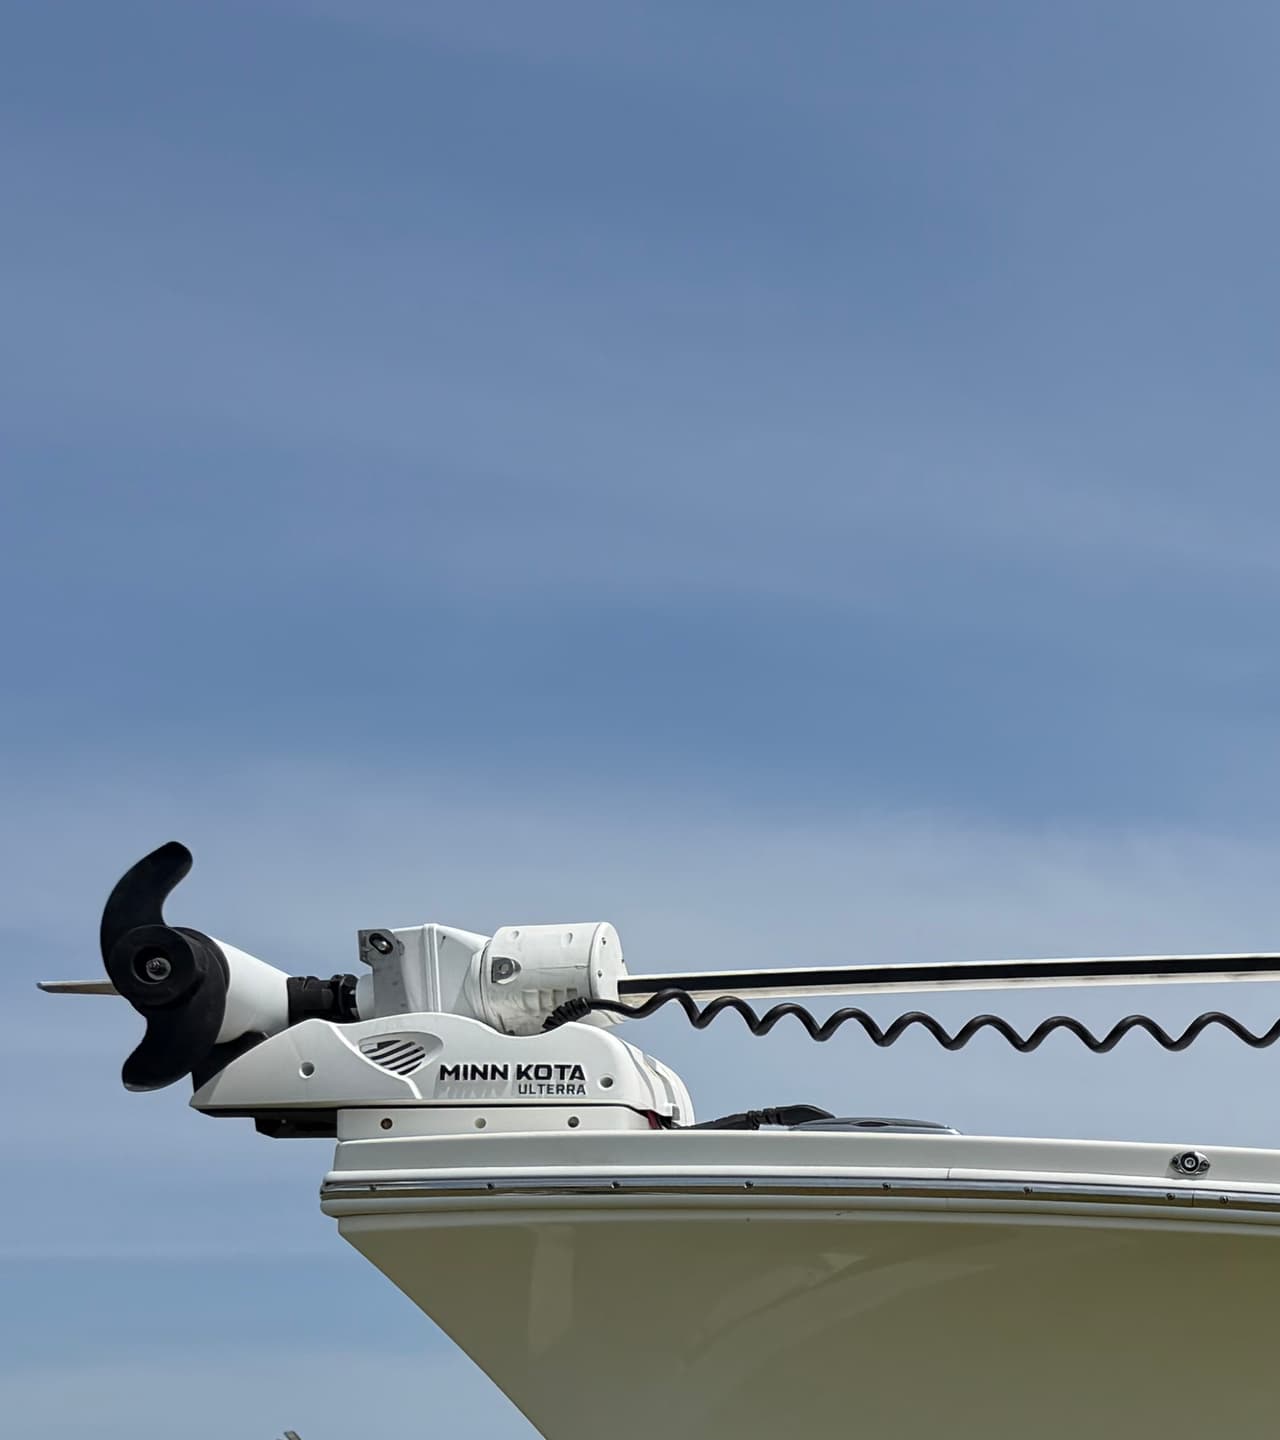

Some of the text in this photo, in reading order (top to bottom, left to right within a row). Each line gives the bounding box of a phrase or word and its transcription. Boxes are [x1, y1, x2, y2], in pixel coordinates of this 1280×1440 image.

[440, 1064, 586, 1081] MINN KOTA
[518, 1083, 586, 1096] ULTERRA
